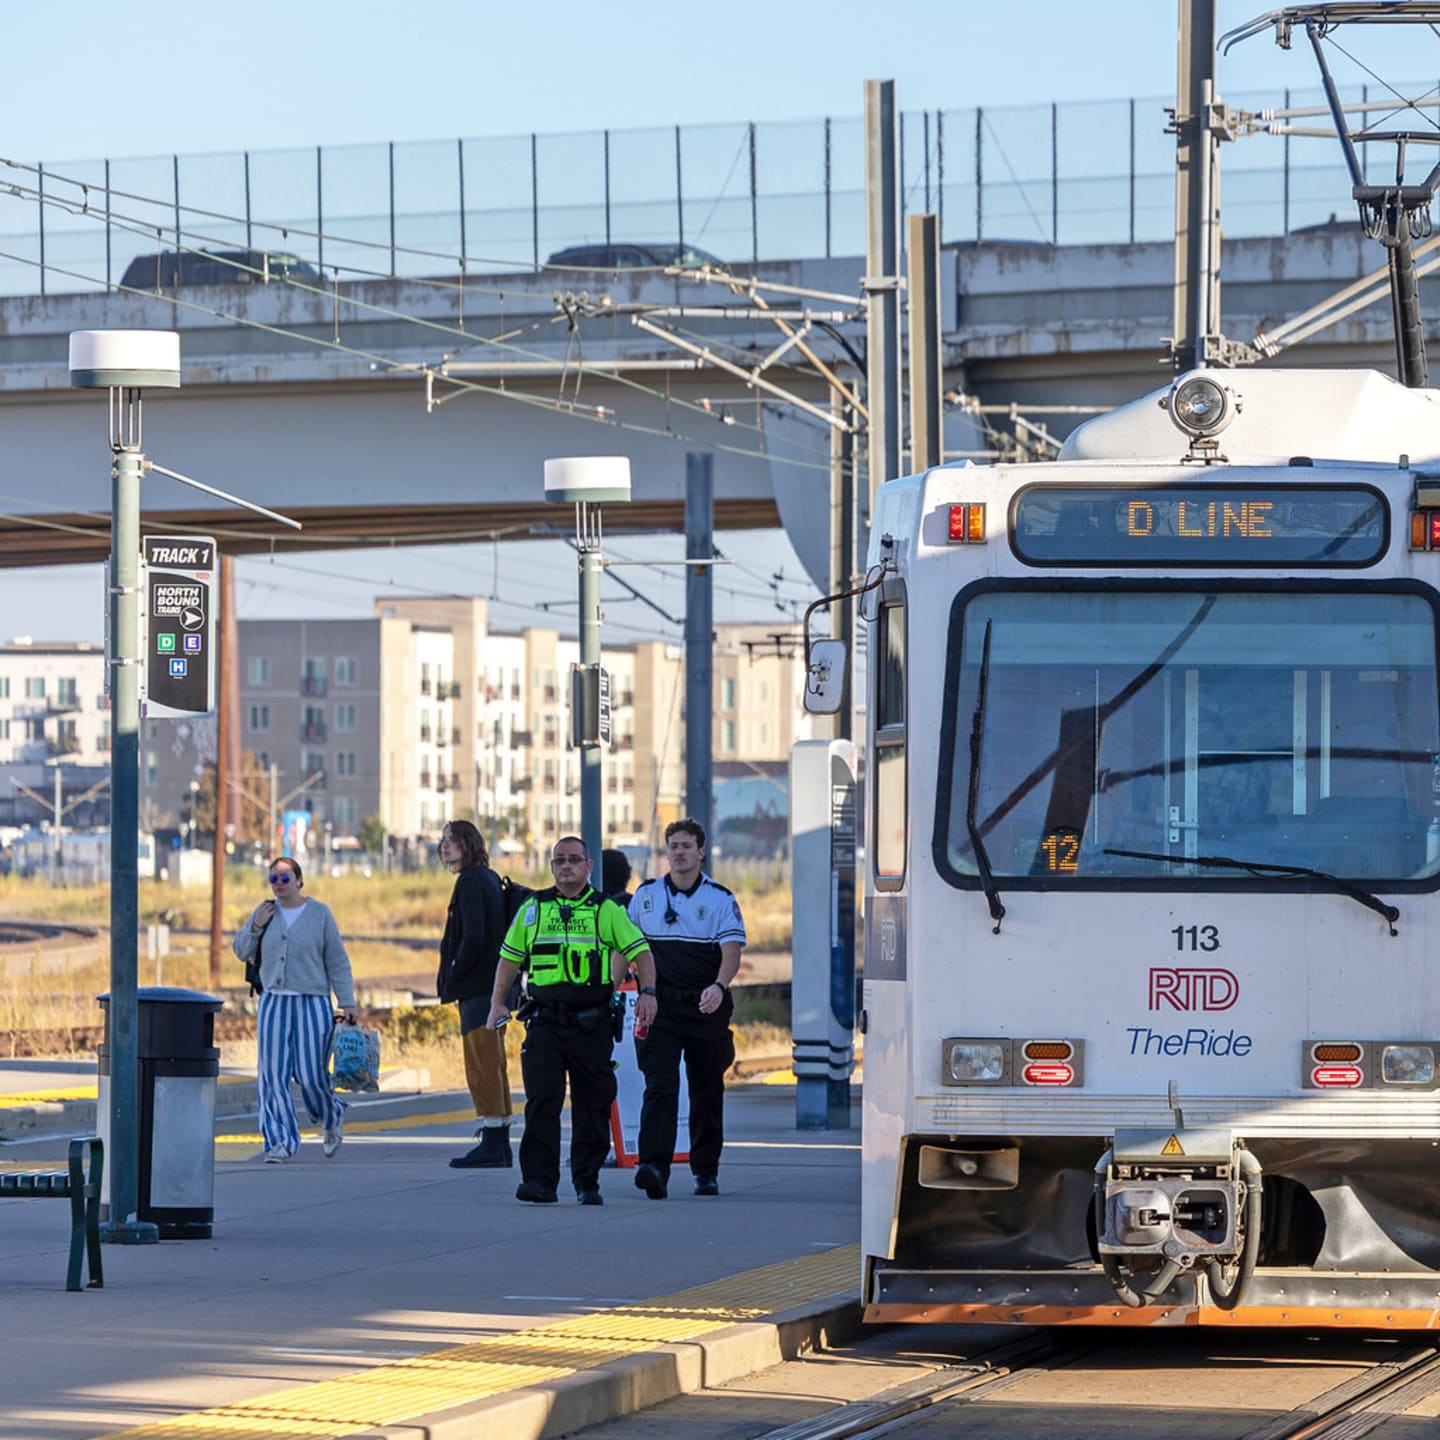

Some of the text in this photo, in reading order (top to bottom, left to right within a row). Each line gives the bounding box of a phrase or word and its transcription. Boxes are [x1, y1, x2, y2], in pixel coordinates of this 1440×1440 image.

[1128, 501, 1273, 537] D LINE
[152, 547, 210, 564] TRACK 1
[157, 587, 199, 596] NORTH
[157, 596, 200, 606] BOUND
[162, 637, 197, 648] D E
[173, 661, 184, 672] H
[1042, 835, 1079, 870] 12
[547, 924, 588, 932] SECURITY
[1171, 925, 1221, 951] 113
[1148, 967, 1240, 1011] RTD
[1126, 1027, 1253, 1057] TheRide
